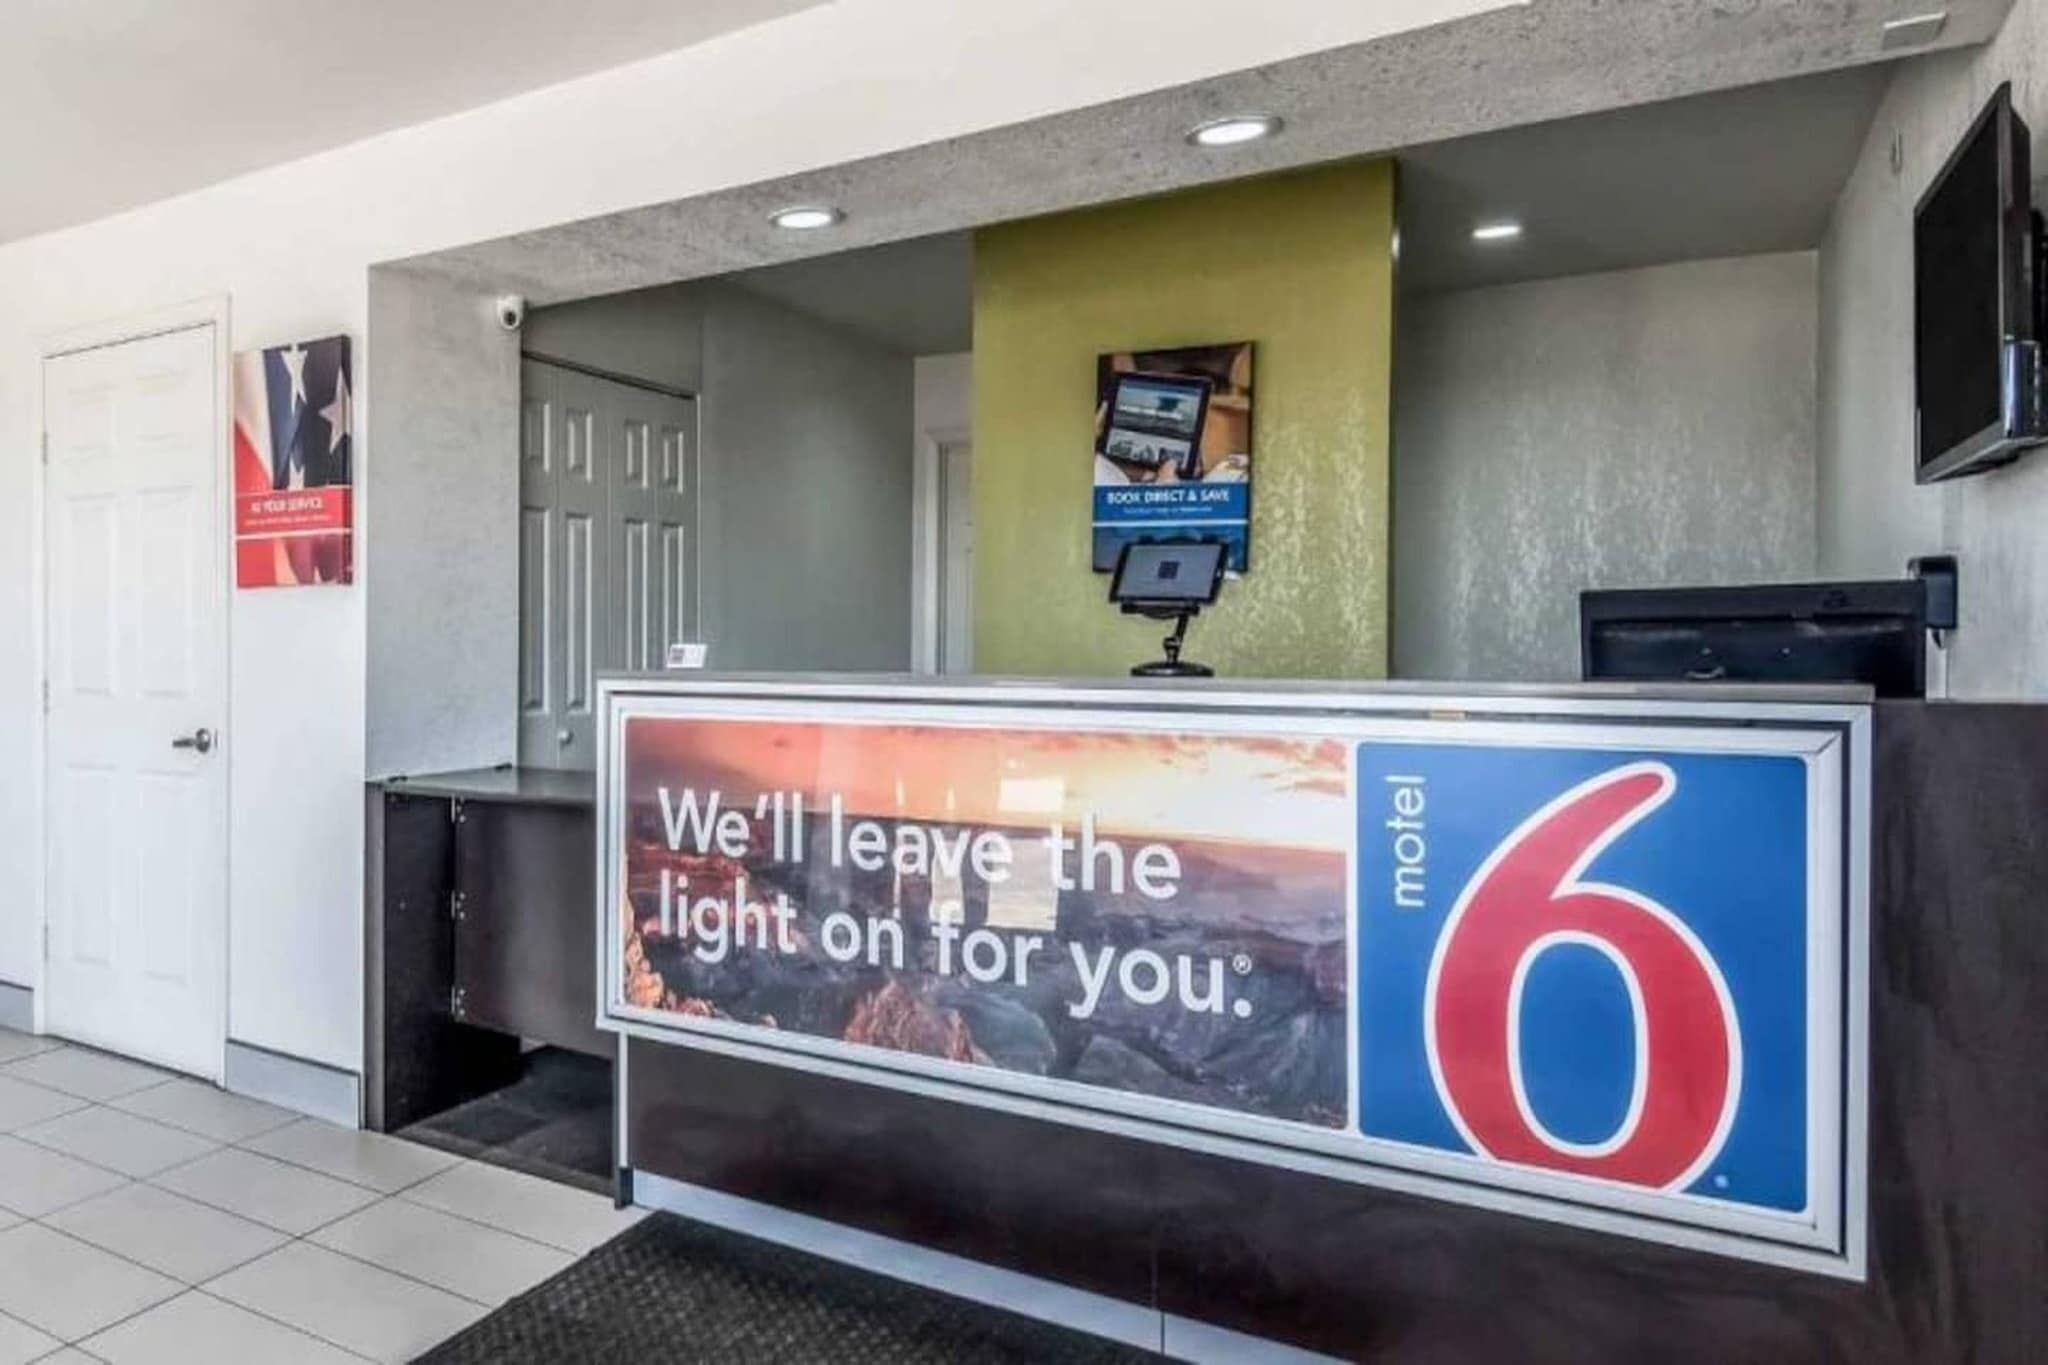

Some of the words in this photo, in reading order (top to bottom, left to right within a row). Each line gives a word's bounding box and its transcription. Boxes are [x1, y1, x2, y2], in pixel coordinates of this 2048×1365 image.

[1107, 491, 1140, 504] BOOK
[1144, 489, 1185, 503] DIRECT
[1200, 487, 1229, 502] SAVE
[658, 787, 802, 863] We'll
[832, 792, 1013, 883] leave
[1044, 810, 1182, 900] the
[660, 868, 798, 964] light
[821, 912, 904, 969] on
[930, 902, 1043, 986] for
[1385, 775, 1425, 907] motel
[1423, 760, 1743, 1195] 6
